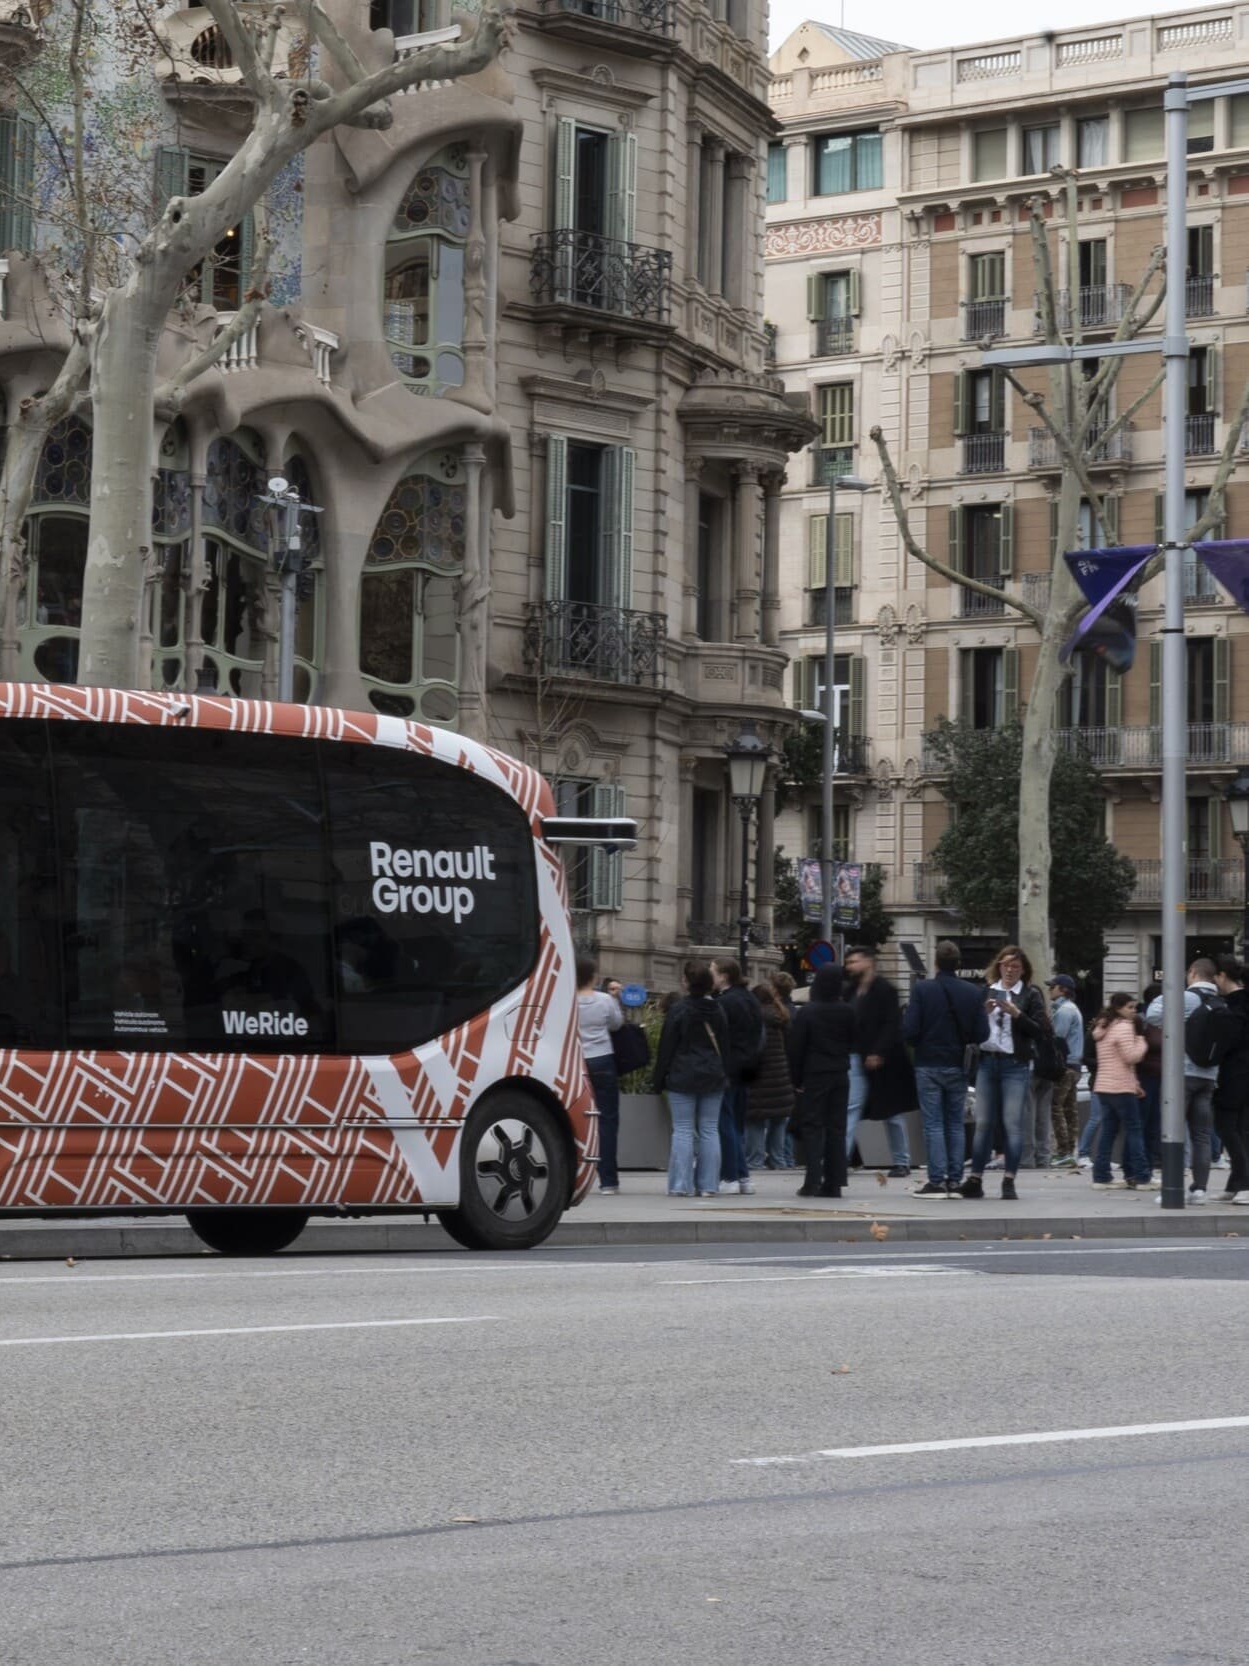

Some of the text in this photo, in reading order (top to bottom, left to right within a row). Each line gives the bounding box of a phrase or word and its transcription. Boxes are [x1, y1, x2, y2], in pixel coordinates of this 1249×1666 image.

[370, 841, 496, 880] Renault
[372, 877, 475, 923] Group
[222, 1010, 309, 1036] WeRide
